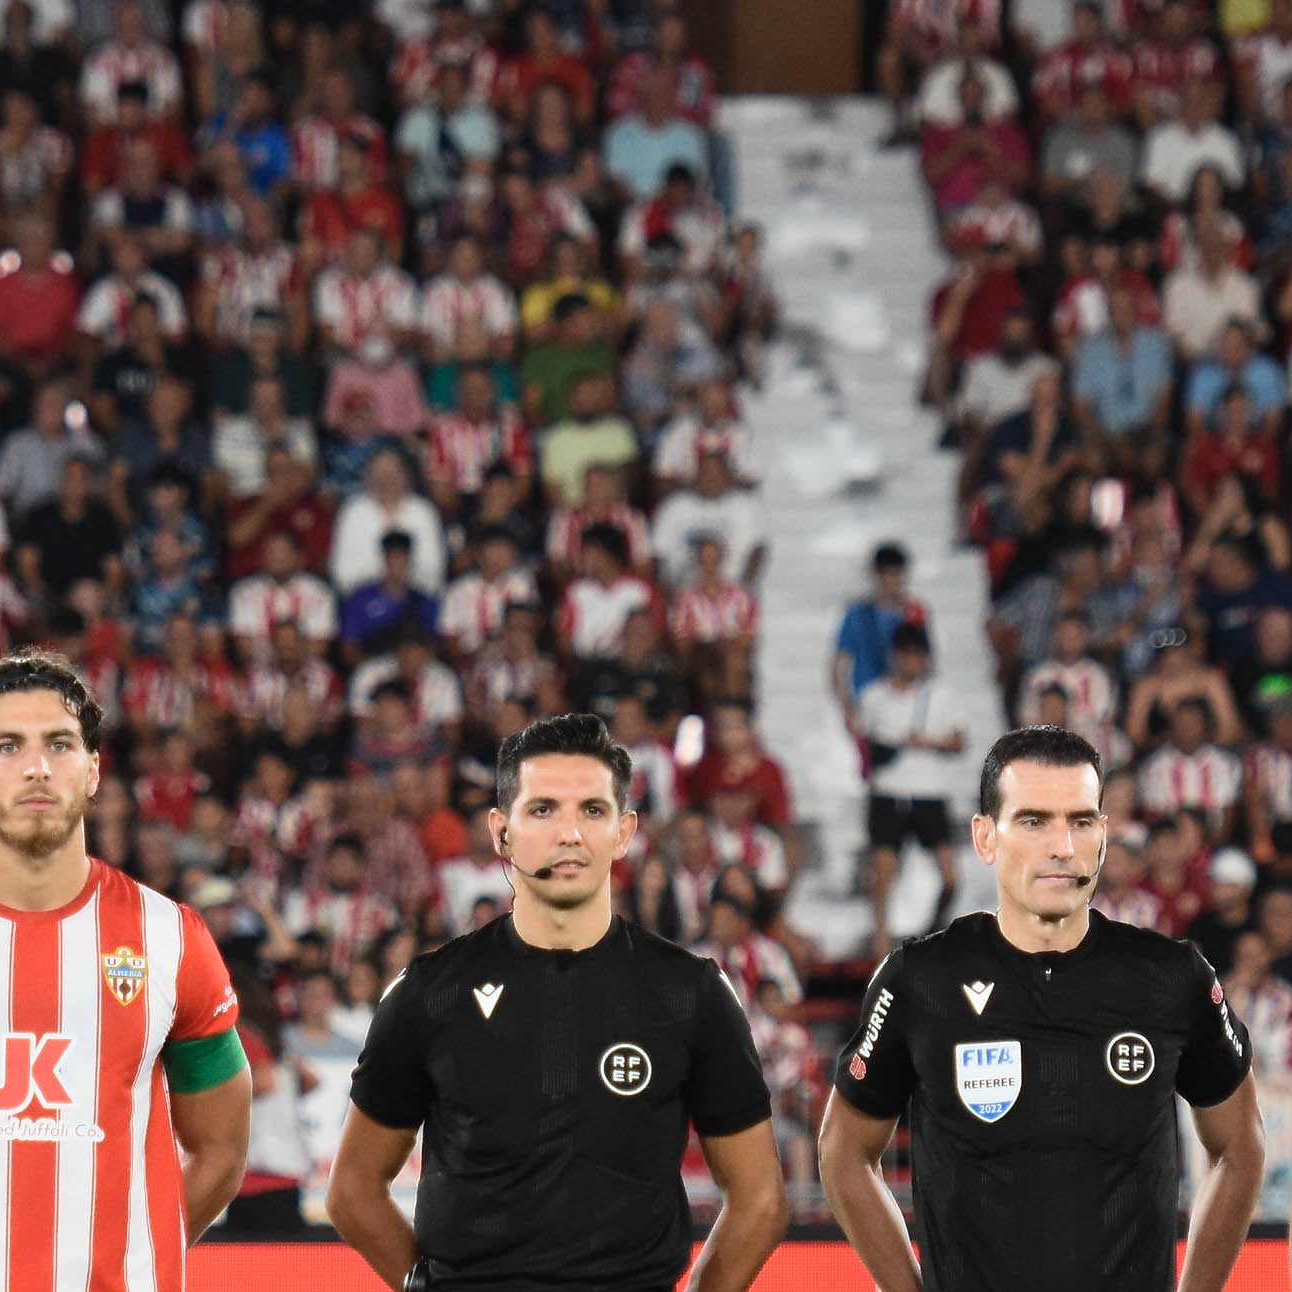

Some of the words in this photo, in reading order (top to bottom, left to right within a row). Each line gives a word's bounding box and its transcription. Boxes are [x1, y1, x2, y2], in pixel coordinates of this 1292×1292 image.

[859, 987, 894, 1059] WÜRTH
[963, 1048, 1014, 1067] FIFA
[963, 1077, 1016, 1089] REFEREE
[979, 1103, 1003, 1114] 2022
